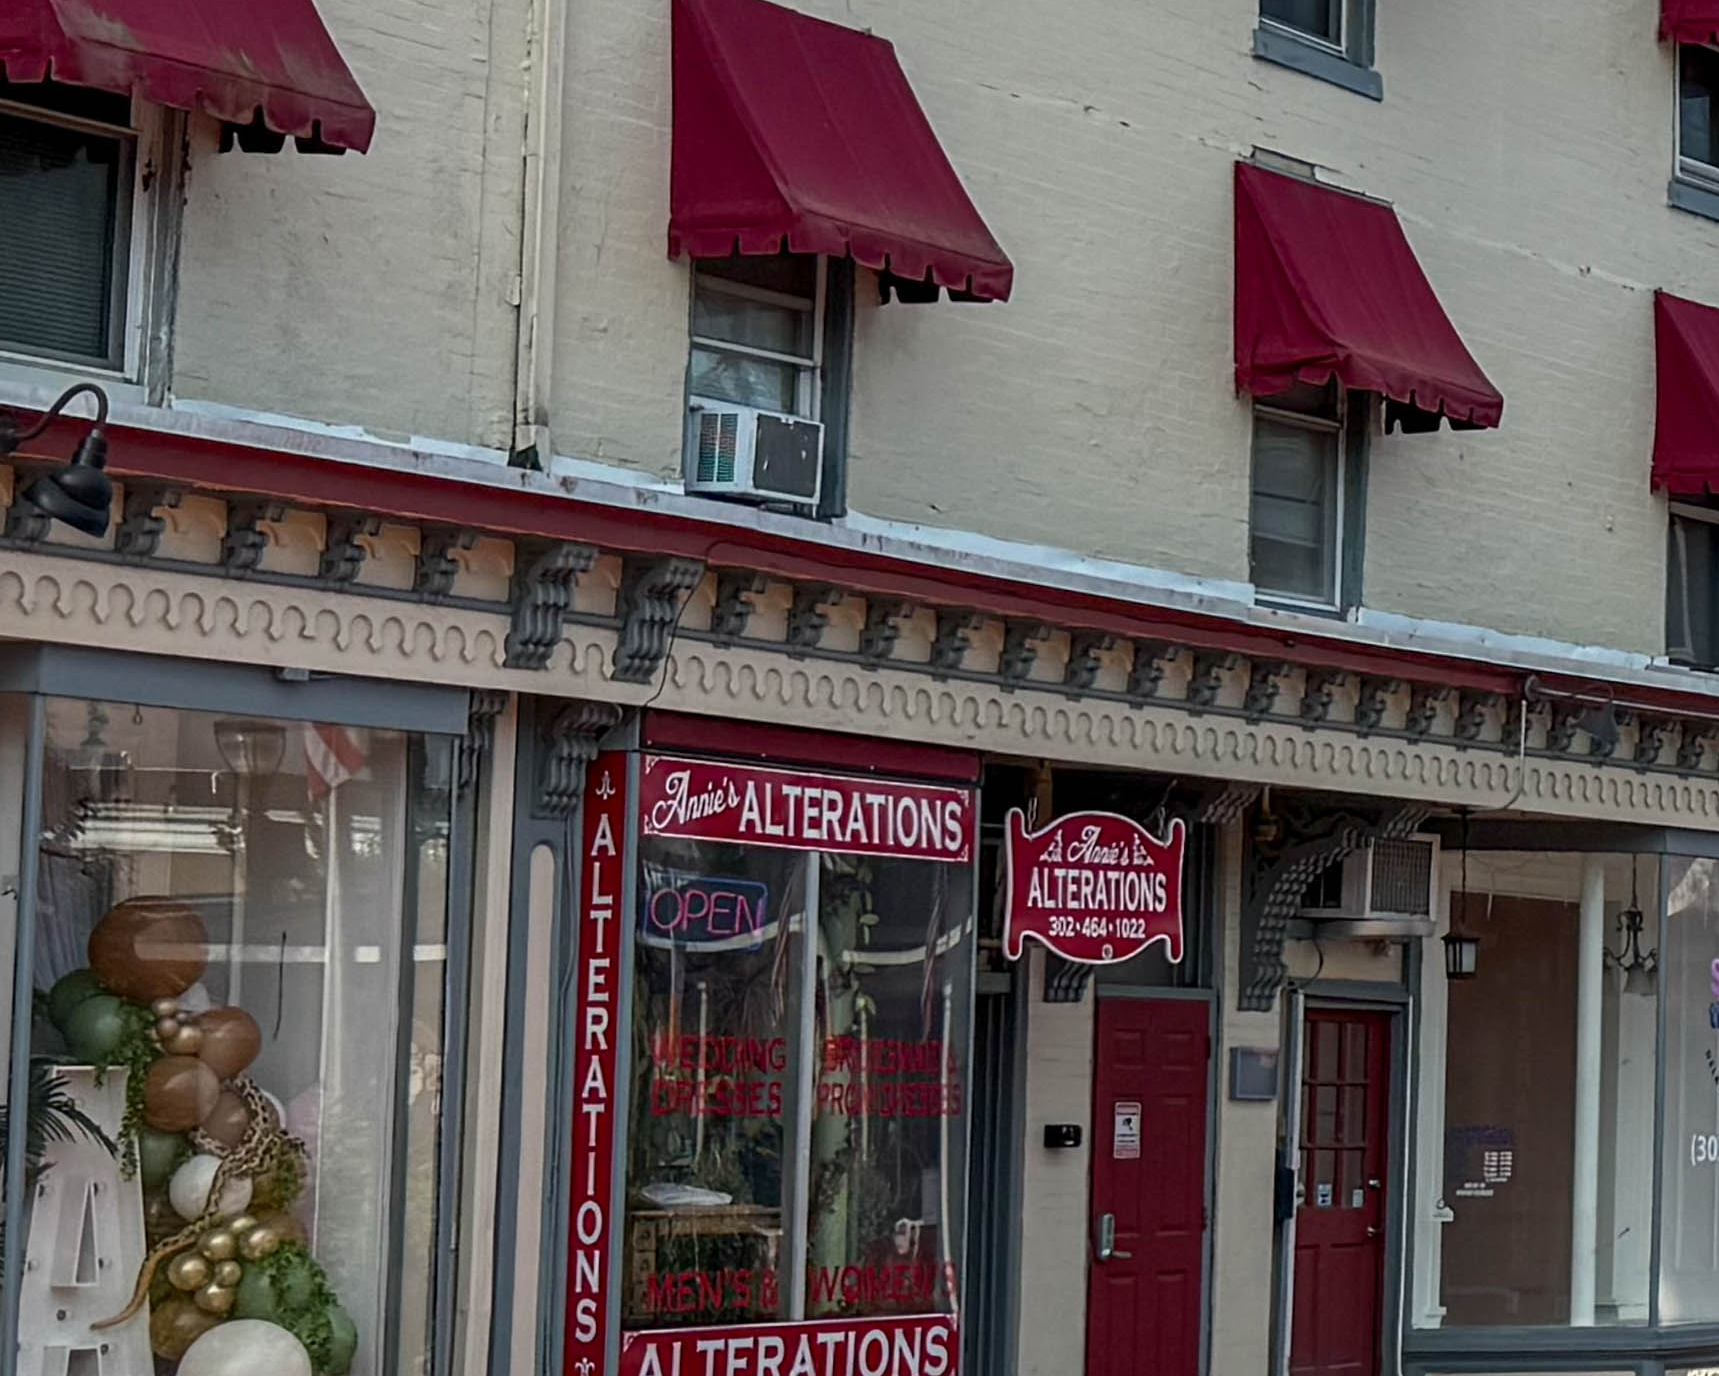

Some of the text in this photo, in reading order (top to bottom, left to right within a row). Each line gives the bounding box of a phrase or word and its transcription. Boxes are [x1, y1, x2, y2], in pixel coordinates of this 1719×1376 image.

[653, 770, 963, 851] Annie's ALTERATIONS
[1067, 825, 1130, 866] Annie's
[650, 886, 764, 935] OPEN
[1027, 867, 1167, 912] ALTERATIONS
[575, 813, 616, 1342] ALTERATIONS
